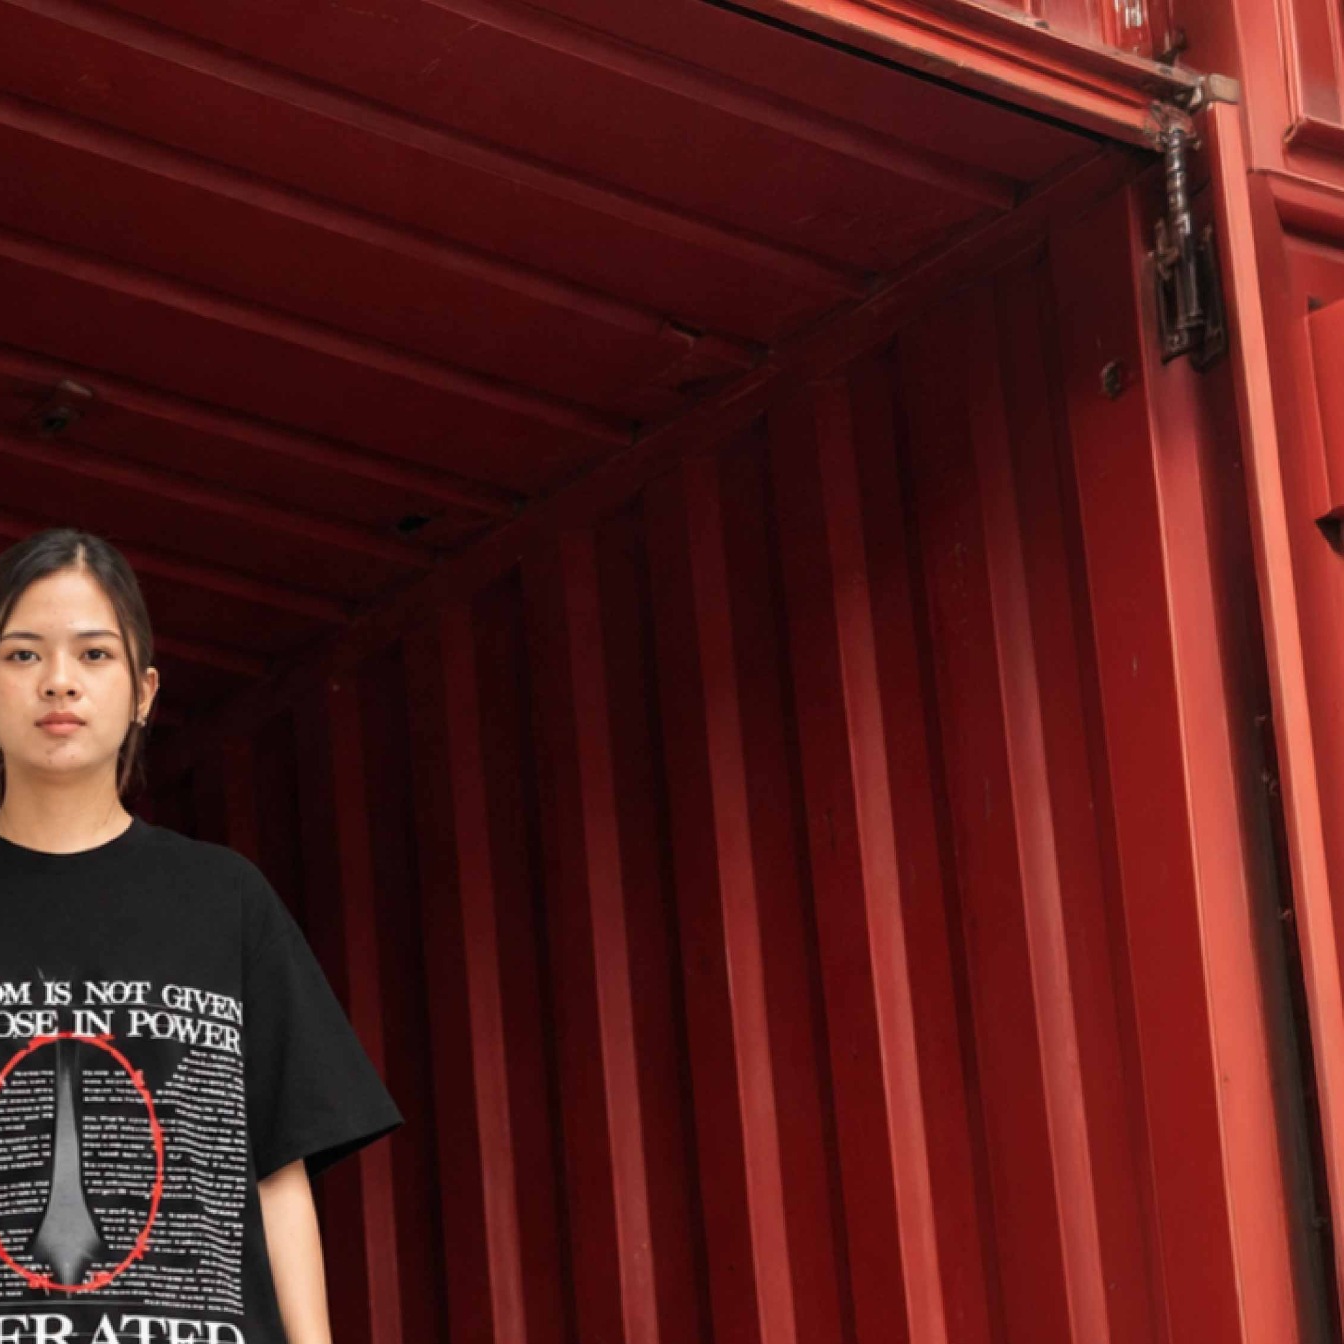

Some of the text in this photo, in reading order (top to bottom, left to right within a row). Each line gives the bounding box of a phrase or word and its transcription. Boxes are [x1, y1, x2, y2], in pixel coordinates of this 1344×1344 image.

[43, 981, 72, 1005] IS
[83, 981, 152, 1006] NOT
[161, 984, 243, 1026] GIVEN
[71, 1010, 114, 1038] IN
[126, 1010, 242, 1056] POWER
